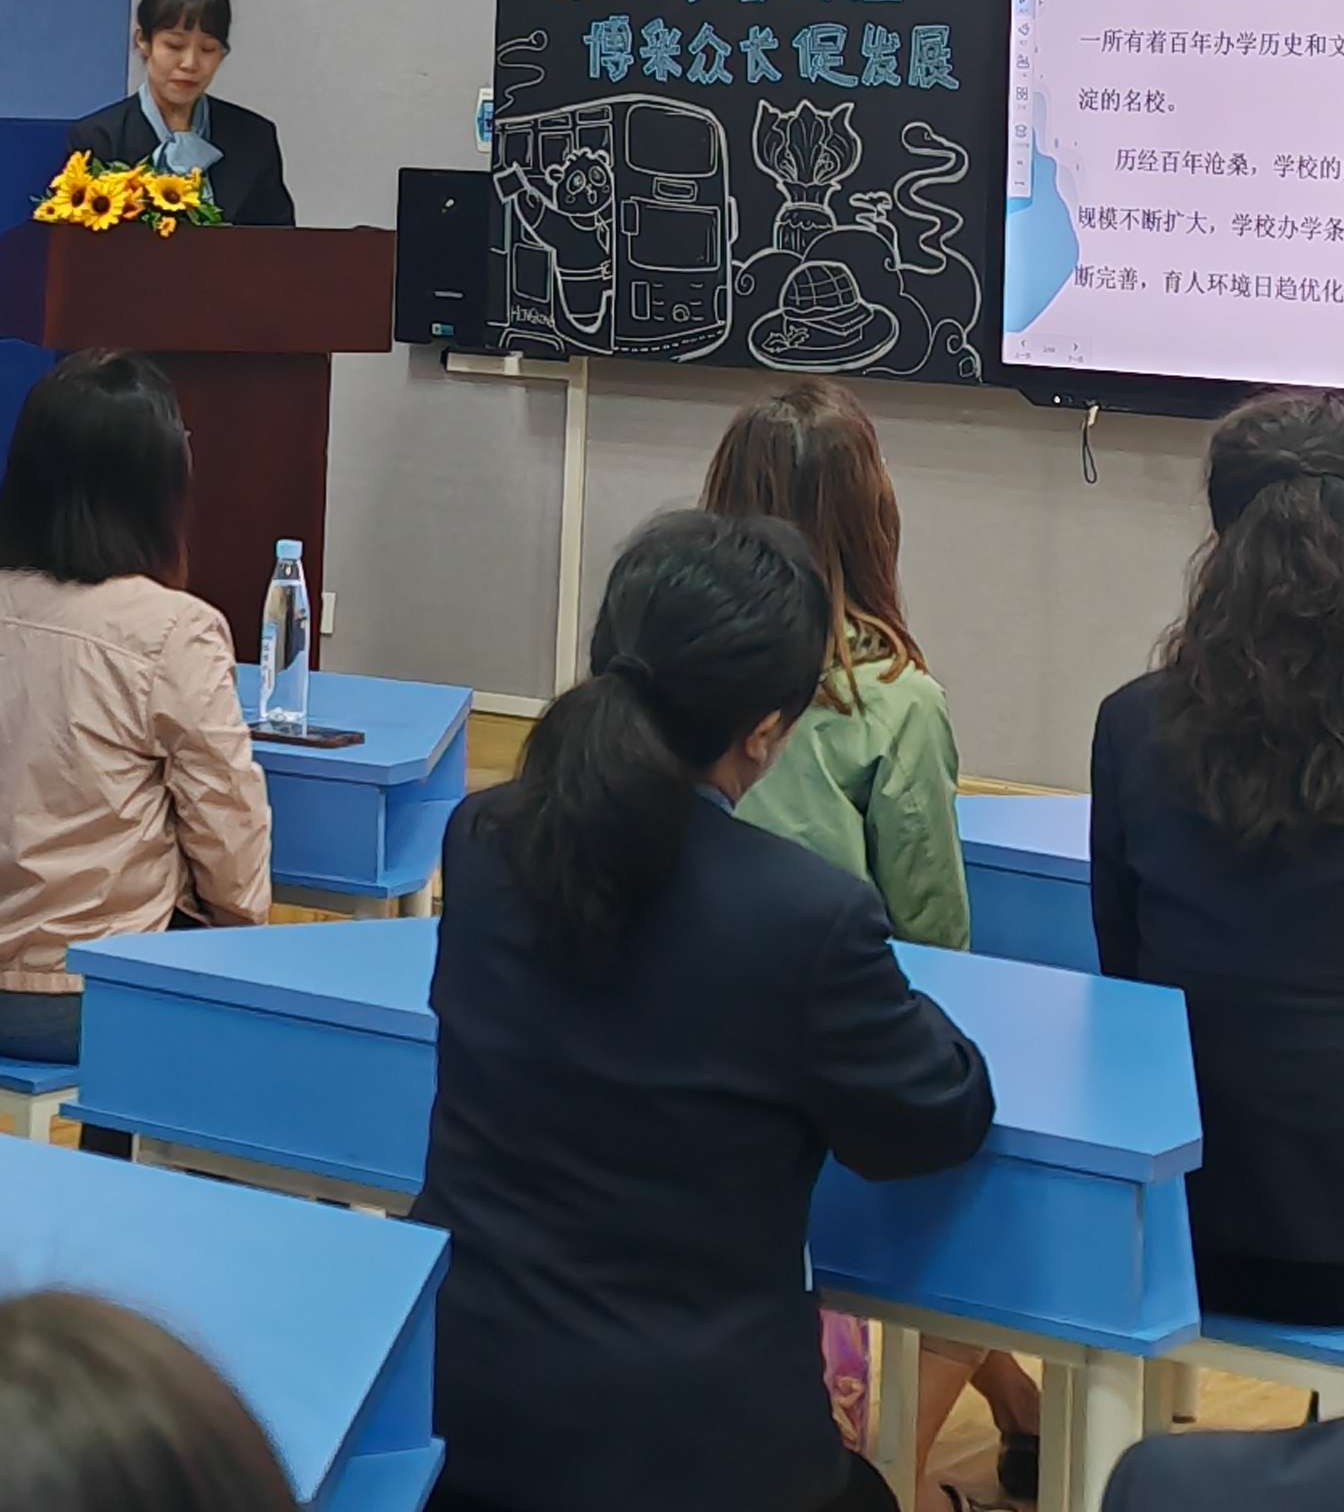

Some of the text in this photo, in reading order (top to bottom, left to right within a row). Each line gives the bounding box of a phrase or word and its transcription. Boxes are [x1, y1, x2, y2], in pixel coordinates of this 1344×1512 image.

[583, 14, 959, 90] 博采众长促发展
[1078, 87, 1177, 114] 淀的名校。
